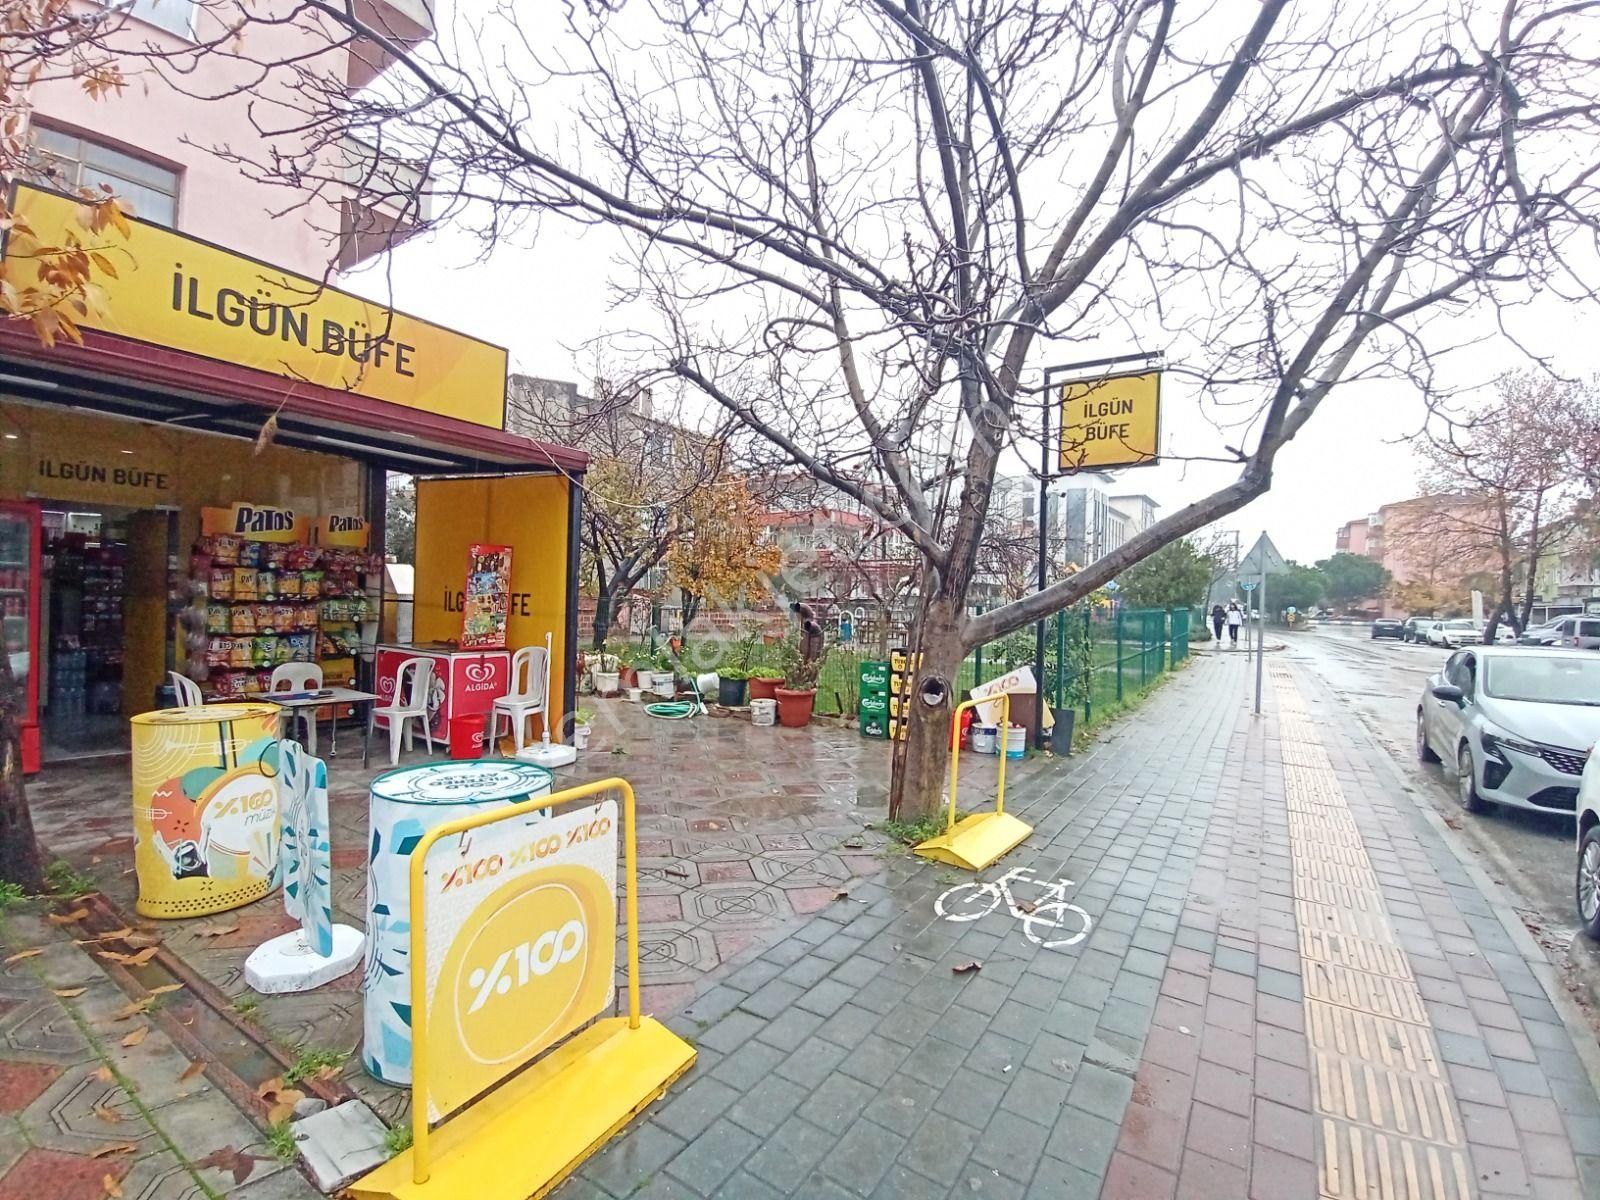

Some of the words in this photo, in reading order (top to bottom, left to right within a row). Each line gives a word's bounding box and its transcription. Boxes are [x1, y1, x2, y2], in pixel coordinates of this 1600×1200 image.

[172, 262, 308, 346] İLGÜN
[322, 320, 416, 378] BÜFE
[1084, 396, 1134, 418] İLGÜN
[1086, 421, 1130, 441] BÜFE
[39, 460, 107, 483] İLGÜN
[113, 467, 169, 490] BÜFE
[444, 585, 464, 613] İLG
[511, 593, 531, 617] FE
[441, 854, 503, 894] %100
[509, 833, 562, 869] %100
[566, 817, 611, 848] %100
[467, 919, 585, 1016] %100
